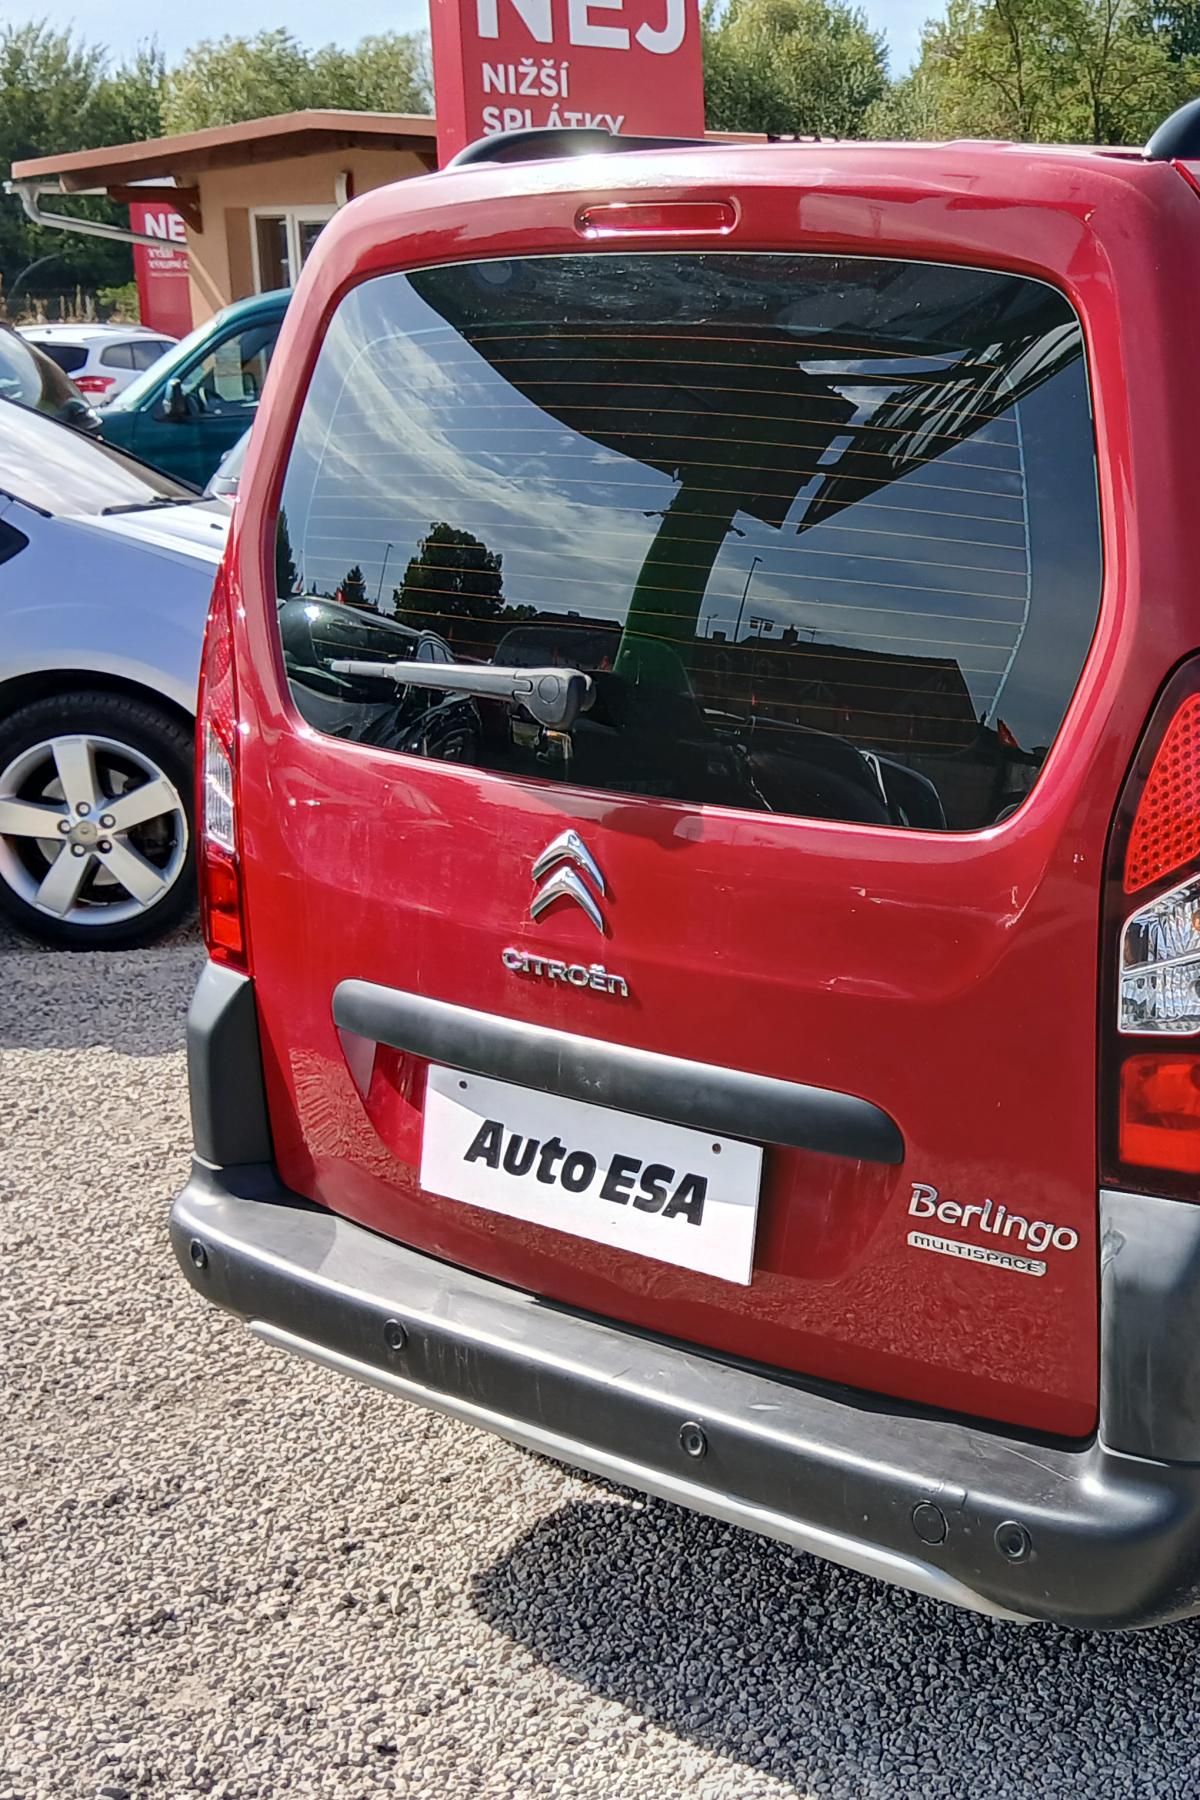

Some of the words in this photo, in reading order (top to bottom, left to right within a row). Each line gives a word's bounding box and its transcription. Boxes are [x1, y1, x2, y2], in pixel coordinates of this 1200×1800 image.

[482, 57, 569, 98] NIŽŠÍ
[463, 1119, 597, 1193] Auto
[599, 1153, 708, 1226] ESA
[908, 1182, 1079, 1252] Berlingo
[913, 1234, 1042, 1274] MULTISPACE
